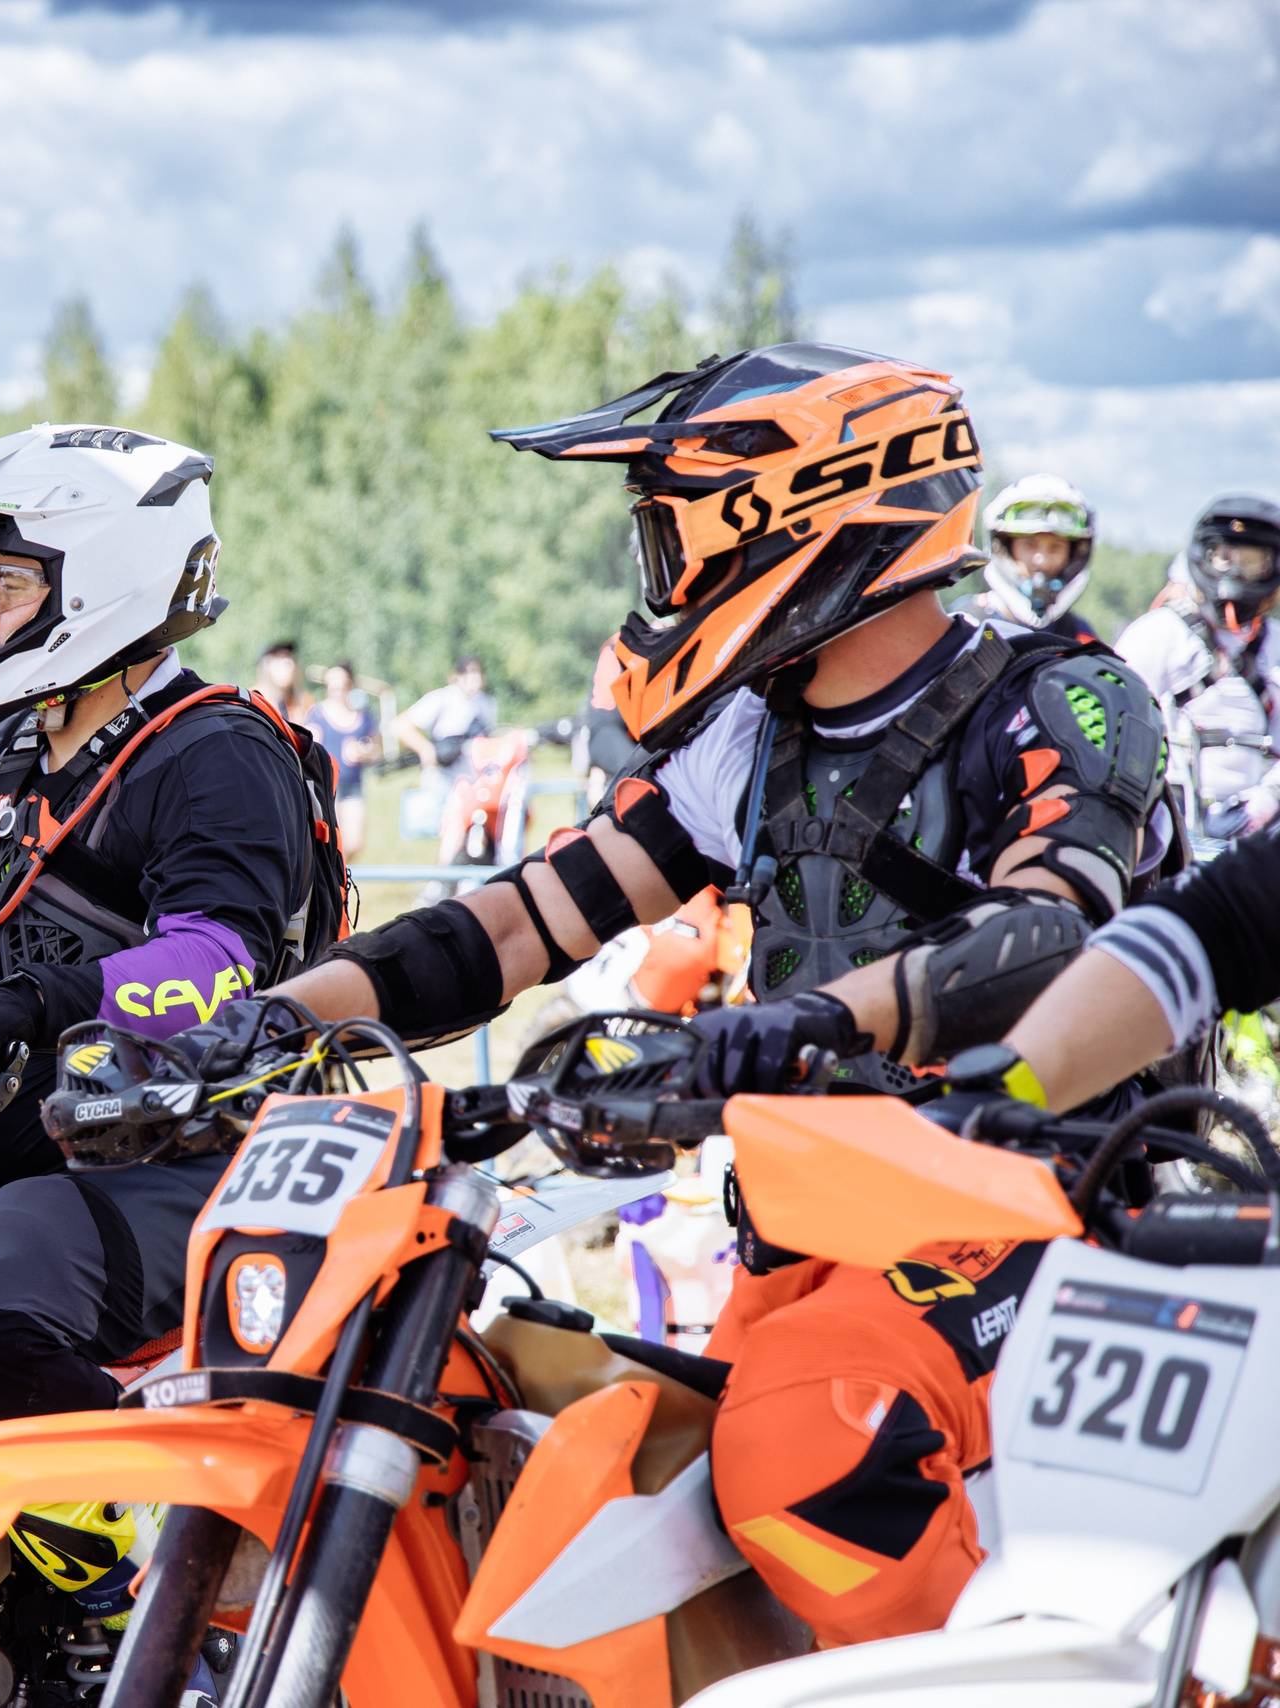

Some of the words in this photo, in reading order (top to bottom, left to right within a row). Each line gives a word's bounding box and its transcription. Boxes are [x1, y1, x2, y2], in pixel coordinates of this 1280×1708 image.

[75, 1100, 122, 1121] CYCRA
[219, 1137, 359, 1206] 335
[971, 1294, 1019, 1349] LEATT
[1030, 1335, 1212, 1454] 320
